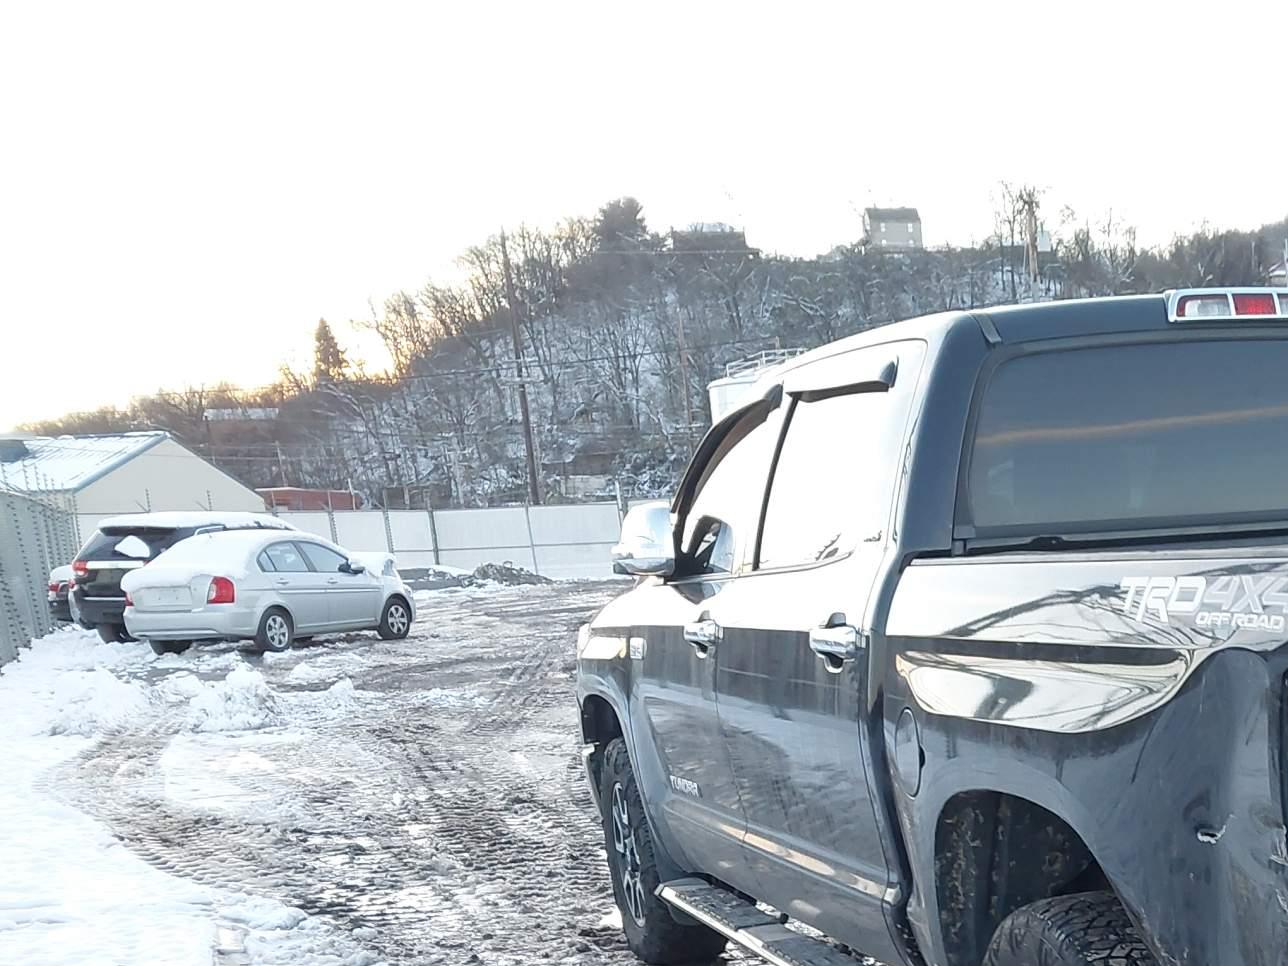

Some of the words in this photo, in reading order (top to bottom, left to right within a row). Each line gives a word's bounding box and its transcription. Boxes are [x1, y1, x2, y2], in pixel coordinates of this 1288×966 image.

[1119, 576, 1207, 623] TRD
[1195, 612, 1233, 627] OFF
[1231, 613, 1286, 633] ROAD
